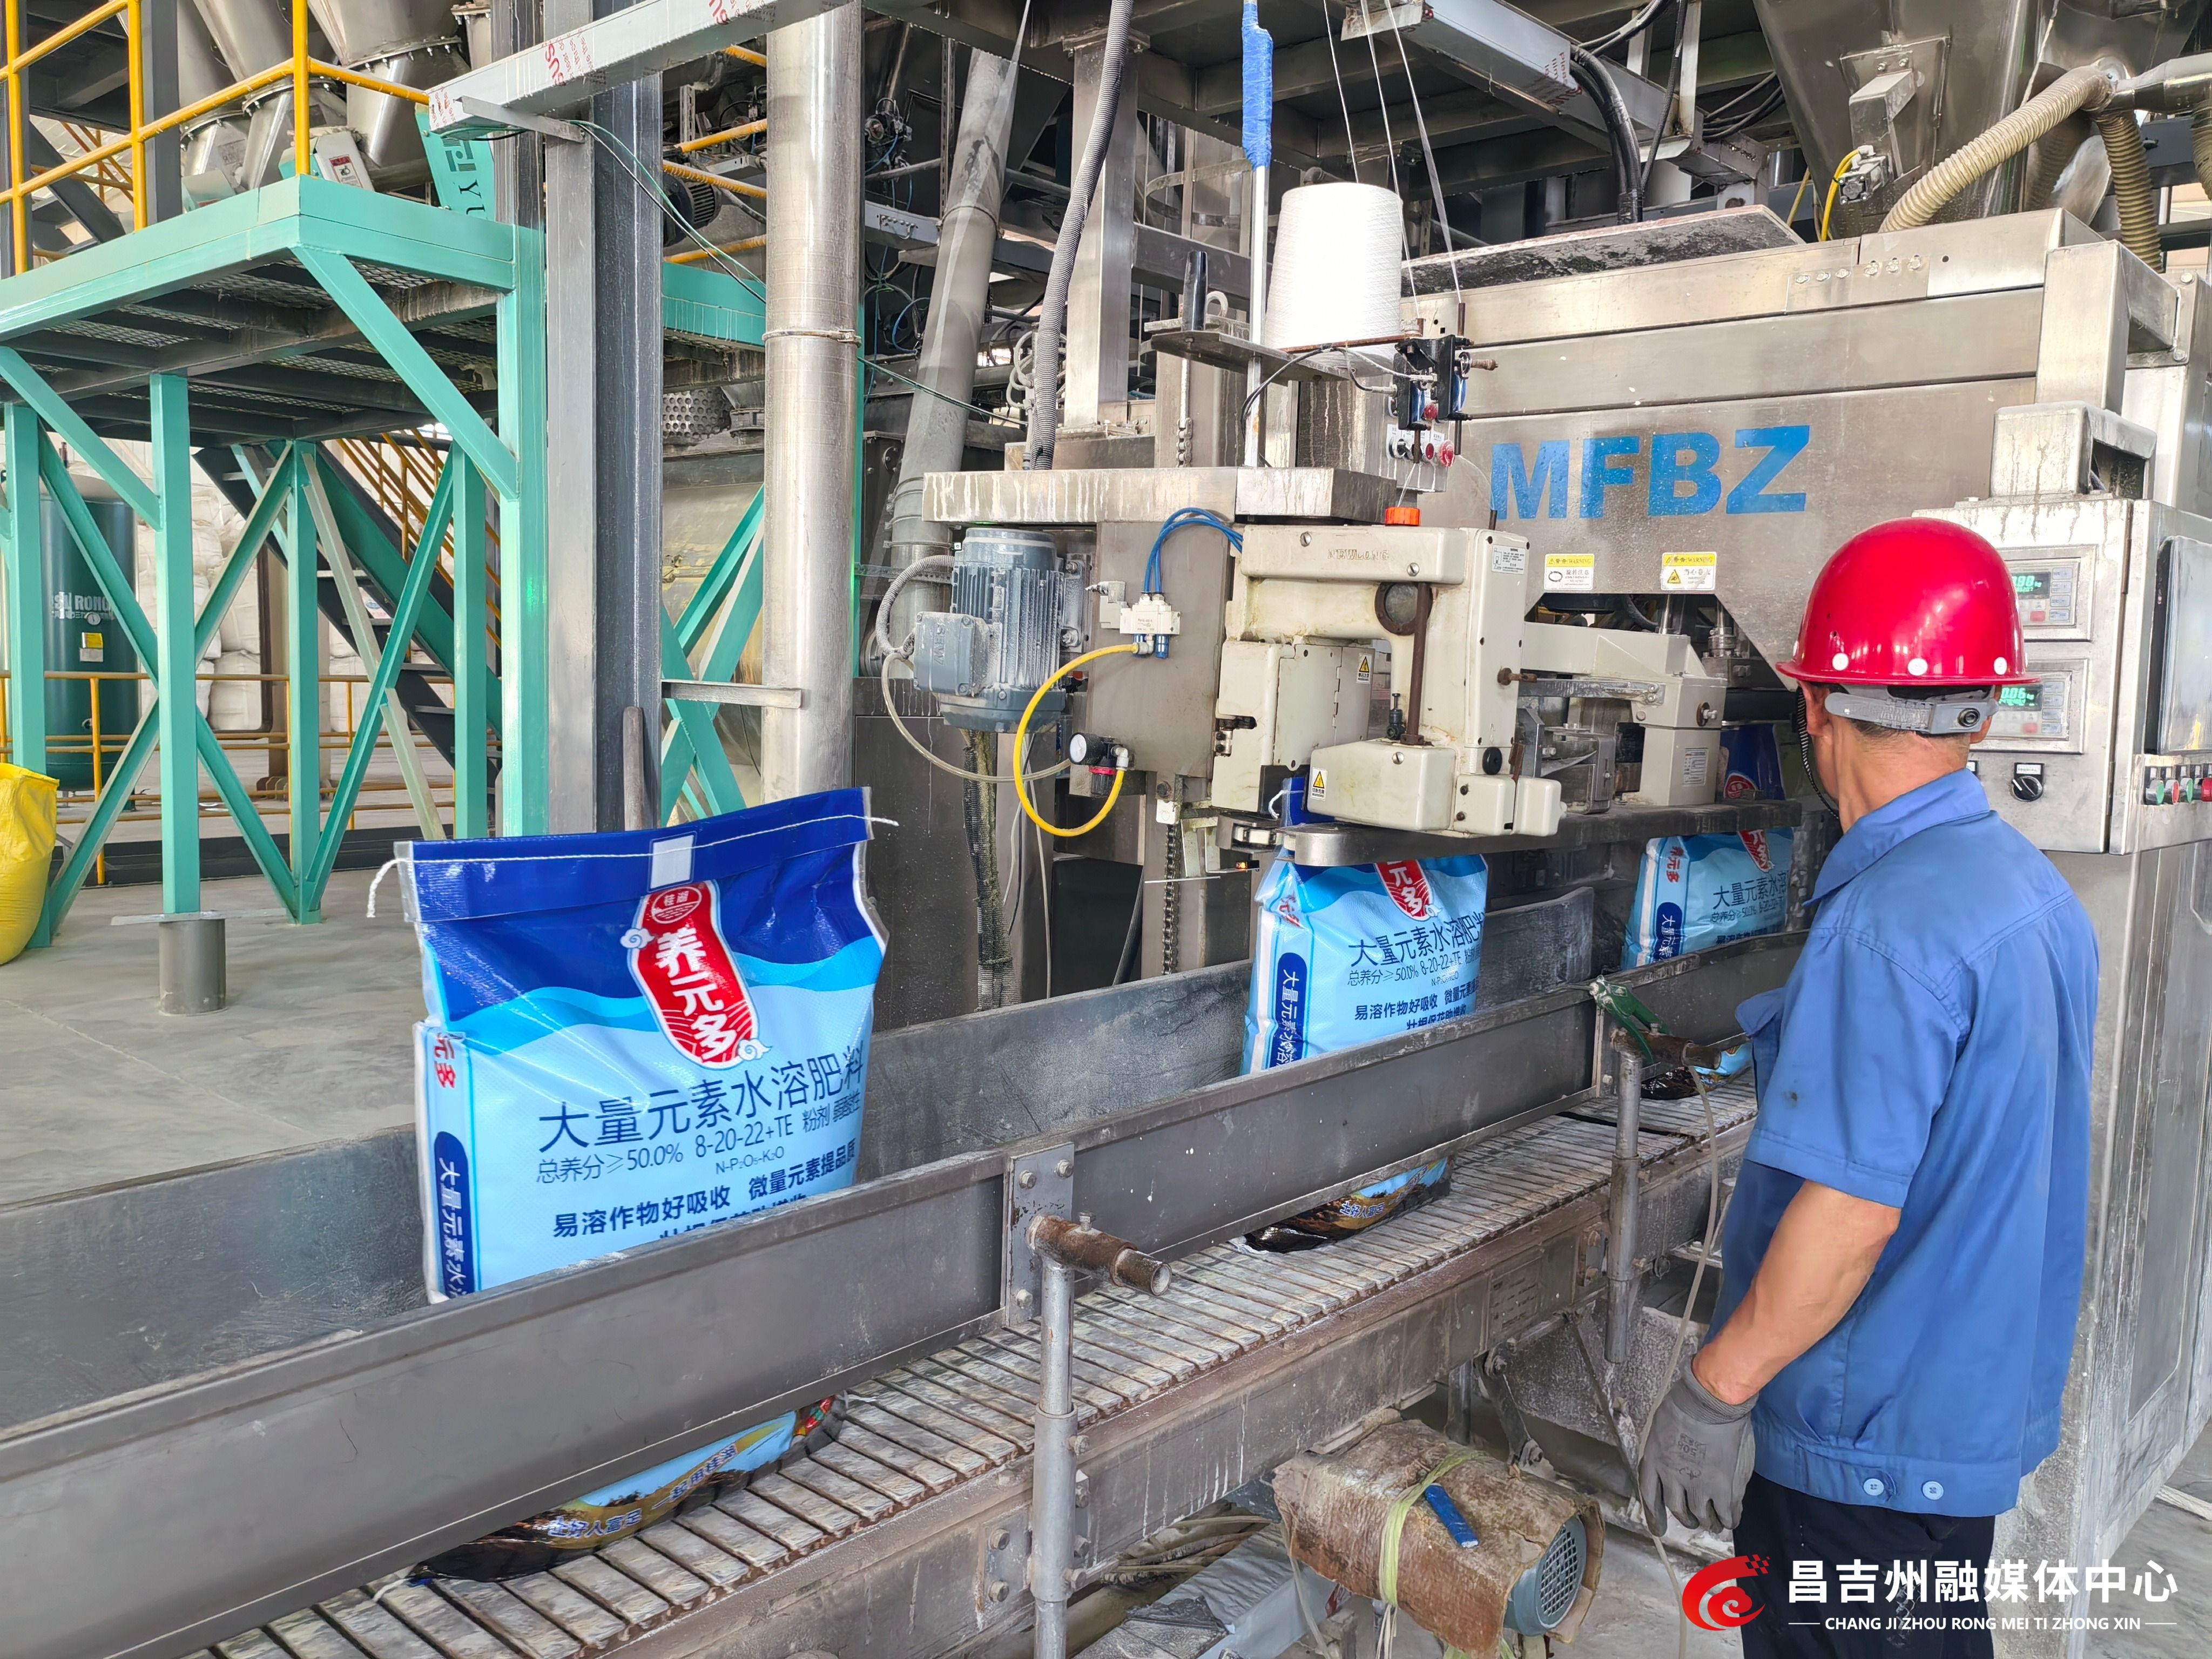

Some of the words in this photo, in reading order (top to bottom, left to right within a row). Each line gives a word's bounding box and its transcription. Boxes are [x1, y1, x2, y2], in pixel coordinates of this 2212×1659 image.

[1490, 425, 1810, 520] MFBZ
[1328, 548, 1389, 561] NEWLONG
[655, 926, 738, 1060] 养元多
[1354, 993, 1438, 1021] 易溶作物好吸收
[538, 1040, 865, 1154] 大量元素水溶肥料
[553, 1184, 731, 1238] 易溶作物好吸收
